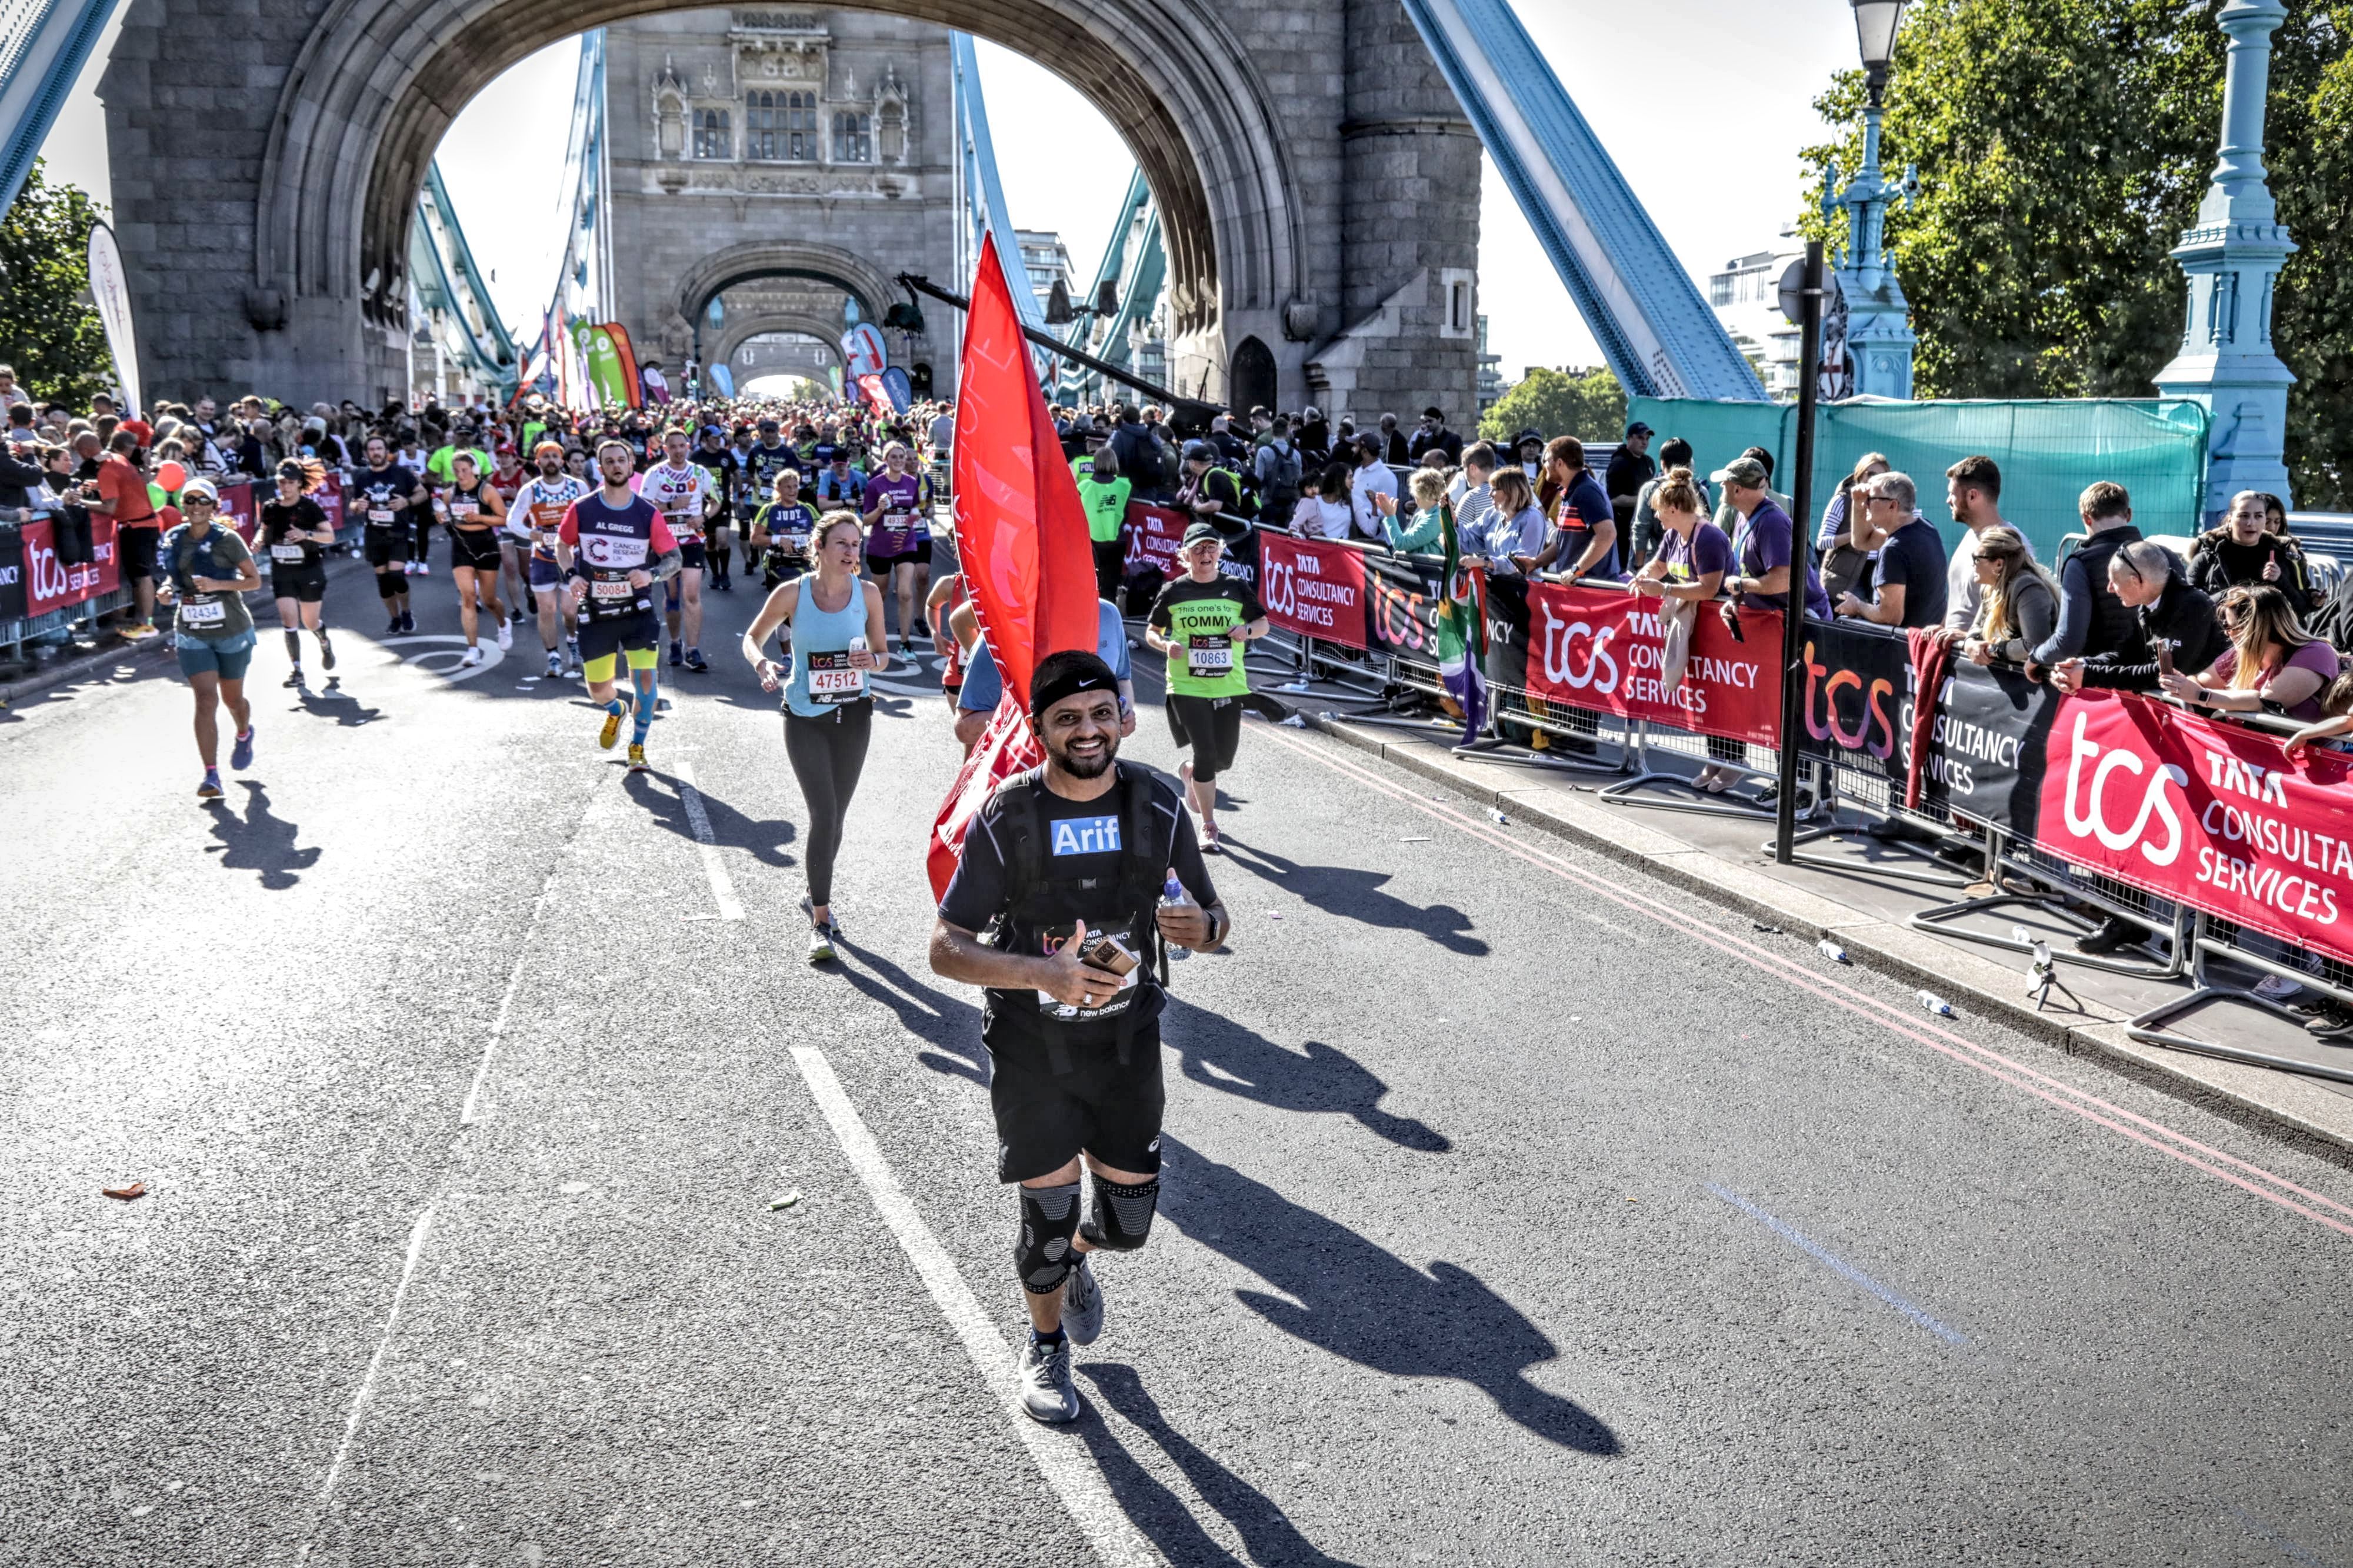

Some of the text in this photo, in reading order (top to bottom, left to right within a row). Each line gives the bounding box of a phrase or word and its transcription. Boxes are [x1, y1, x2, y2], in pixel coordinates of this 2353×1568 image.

[776, 509, 801, 521] JUDY
[1145, 516, 1164, 533] TATA
[608, 523, 634, 533] GREGG
[1146, 535, 1182, 554] CONSULTANC
[1296, 553, 1320, 575] TATA
[596, 584, 626, 595] 50084
[1264, 546, 1294, 616] tcs
[1297, 578, 1355, 606] CONSULTANCY
[186, 606, 218, 619] 12434
[1297, 602, 1333, 627] SERVICES
[1373, 570, 1424, 649] tcs
[1179, 616, 1232, 628] TOMMY
[1626, 611, 1667, 639] TAT
[1192, 636, 1208, 648] tcs
[1542, 602, 1618, 694] tcs
[812, 655, 833, 668] tcs
[1194, 652, 1227, 665] 10863
[1627, 643, 1759, 689] CONLTANCY
[816, 671, 858, 689] 47512
[1626, 676, 1707, 713] SERVICES
[1804, 640, 1893, 759] tcs
[1902, 703, 2025, 770] CSULTANCY
[2064, 711, 2189, 866] tcs
[2205, 749, 2288, 809] TATA
[1054, 818, 1118, 853] Arif
[2202, 799, 2353, 880] CONSULTA
[2195, 846, 2339, 925] SERVICES
[1043, 931, 1065, 955] tc
[1086, 929, 1103, 938] ATA
[1080, 1009, 1097, 1017] new
[1099, 1000, 1131, 1015] balance
